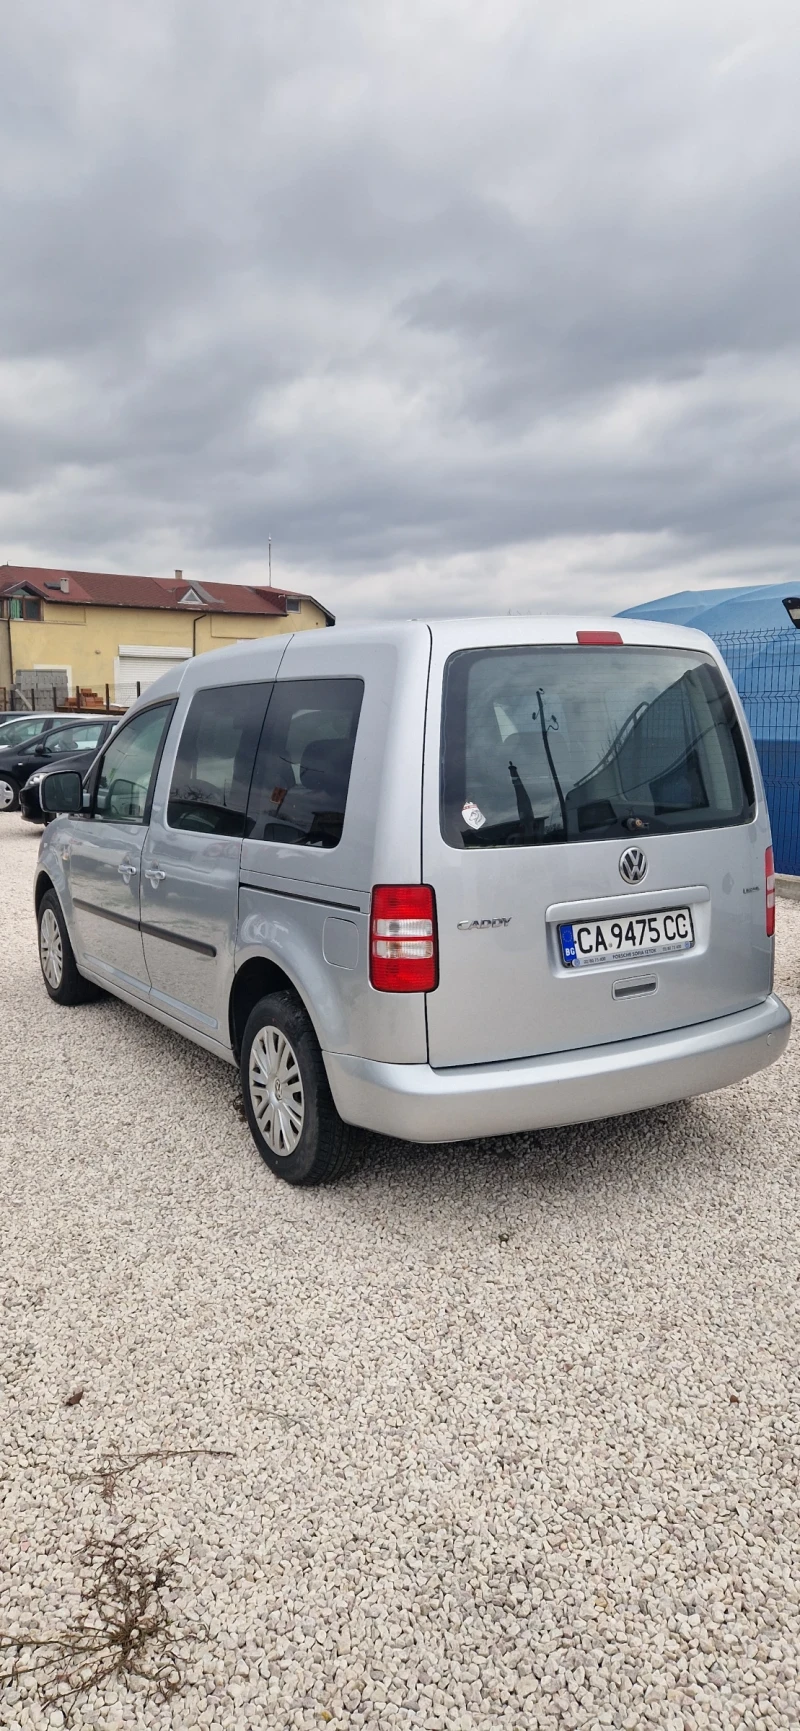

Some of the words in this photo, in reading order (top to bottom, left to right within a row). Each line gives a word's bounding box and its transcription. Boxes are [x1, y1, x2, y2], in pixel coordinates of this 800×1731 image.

[457, 916, 512, 930] CADDY
[577, 925, 608, 954] CA
[611, 918, 660, 949] 9475
[663, 913, 688, 941] CC
[565, 947, 576, 957] BG
